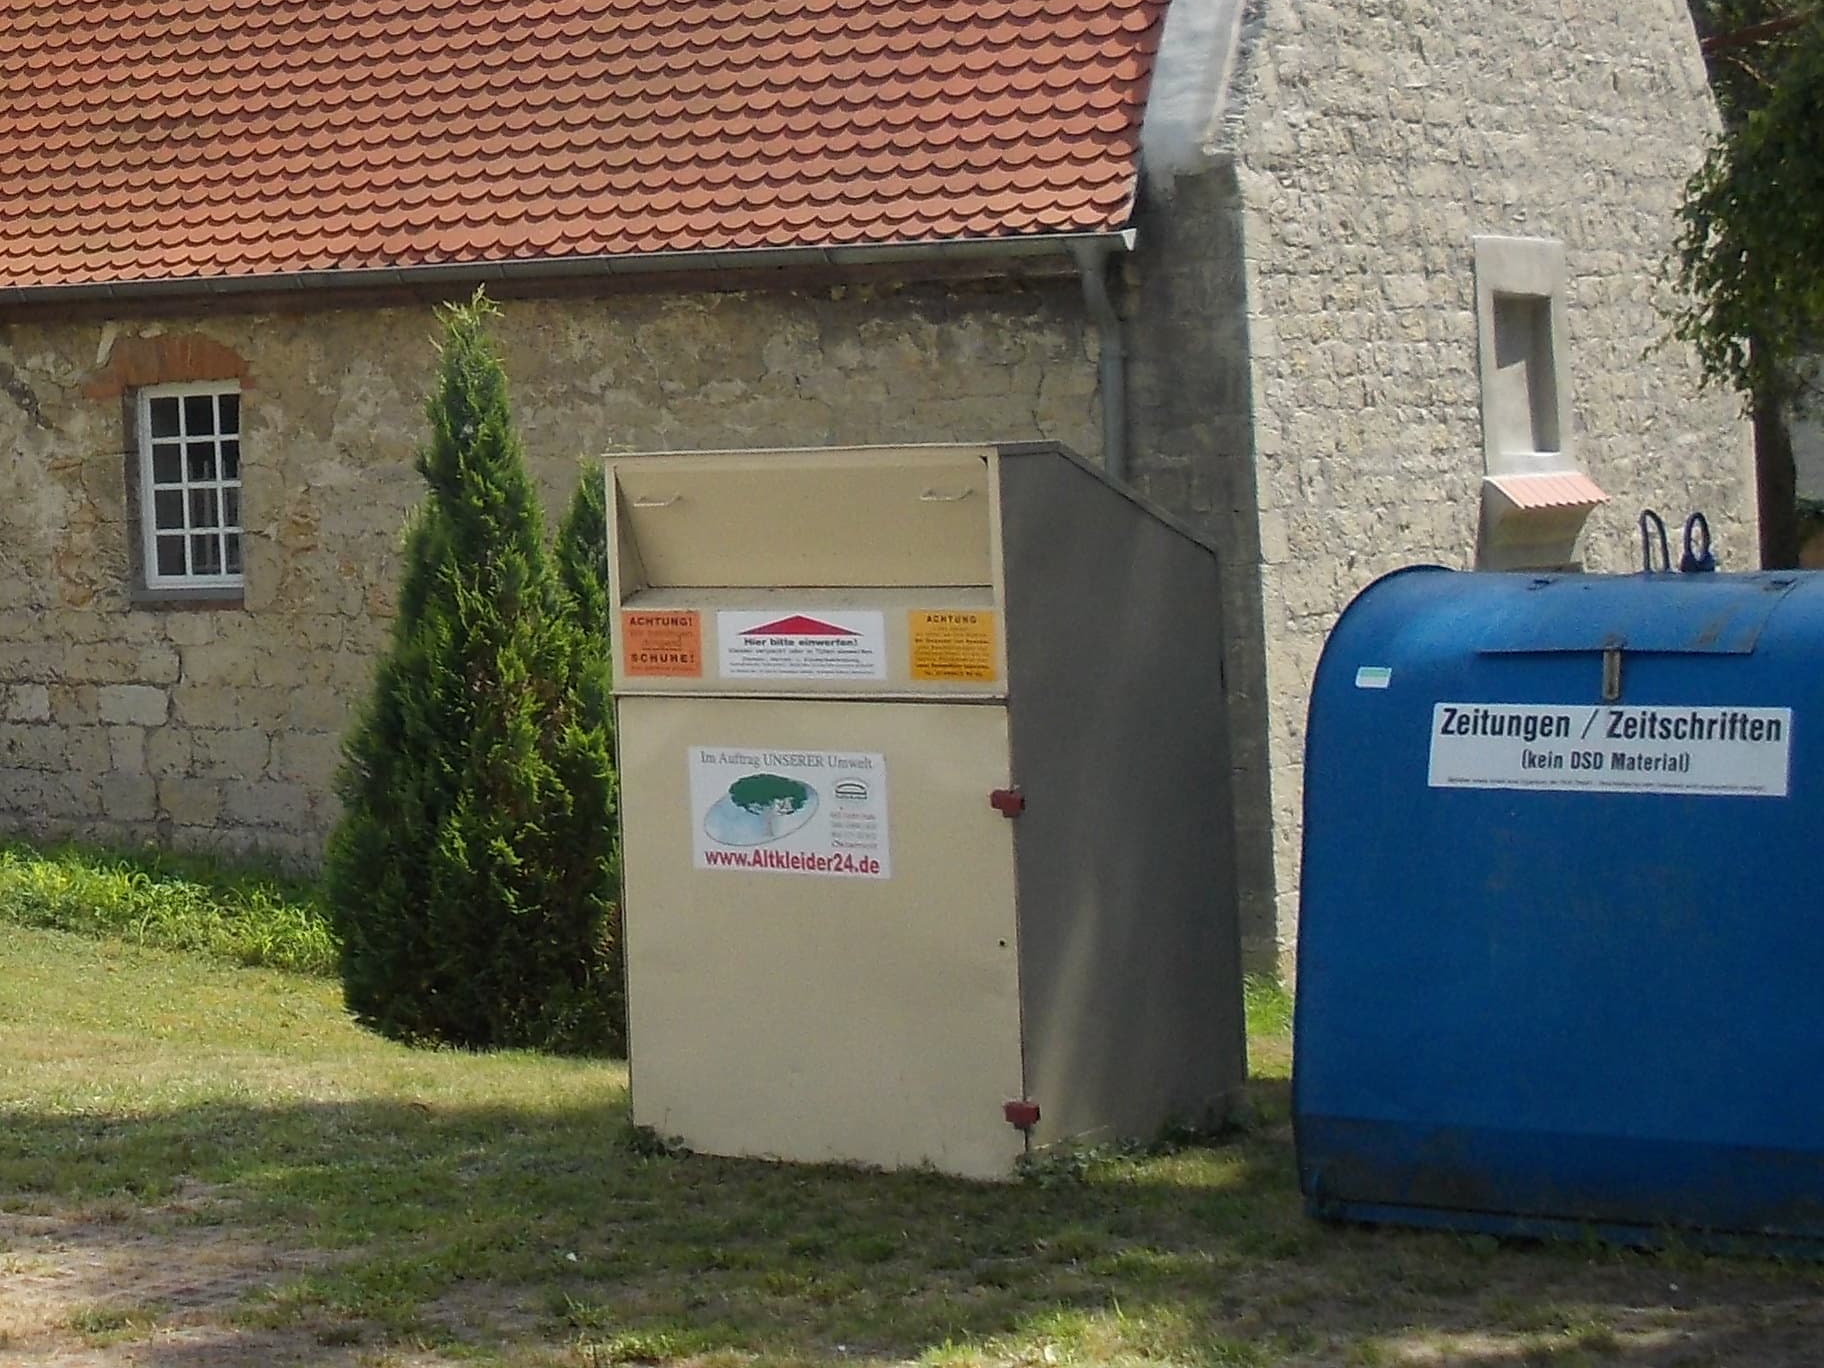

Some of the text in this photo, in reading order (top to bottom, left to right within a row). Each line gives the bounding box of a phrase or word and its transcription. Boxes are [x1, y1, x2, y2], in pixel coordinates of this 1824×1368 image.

[630, 616, 693, 627] ACHTUNG!
[926, 615, 977, 624] ACHTUNG
[744, 638, 858, 647] Hier bitte einwerfen!
[630, 653, 695, 664] SCHUHE!
[1440, 707, 1571, 742] Zeitungen
[1605, 710, 1782, 742] Zeitschriften
[700, 750, 873, 770] Im Auftrag UNSERER Umwelt
[1521, 748, 1691, 773] (kein DSD Material)
[704, 848, 881, 874] www.Altkleider24.de
